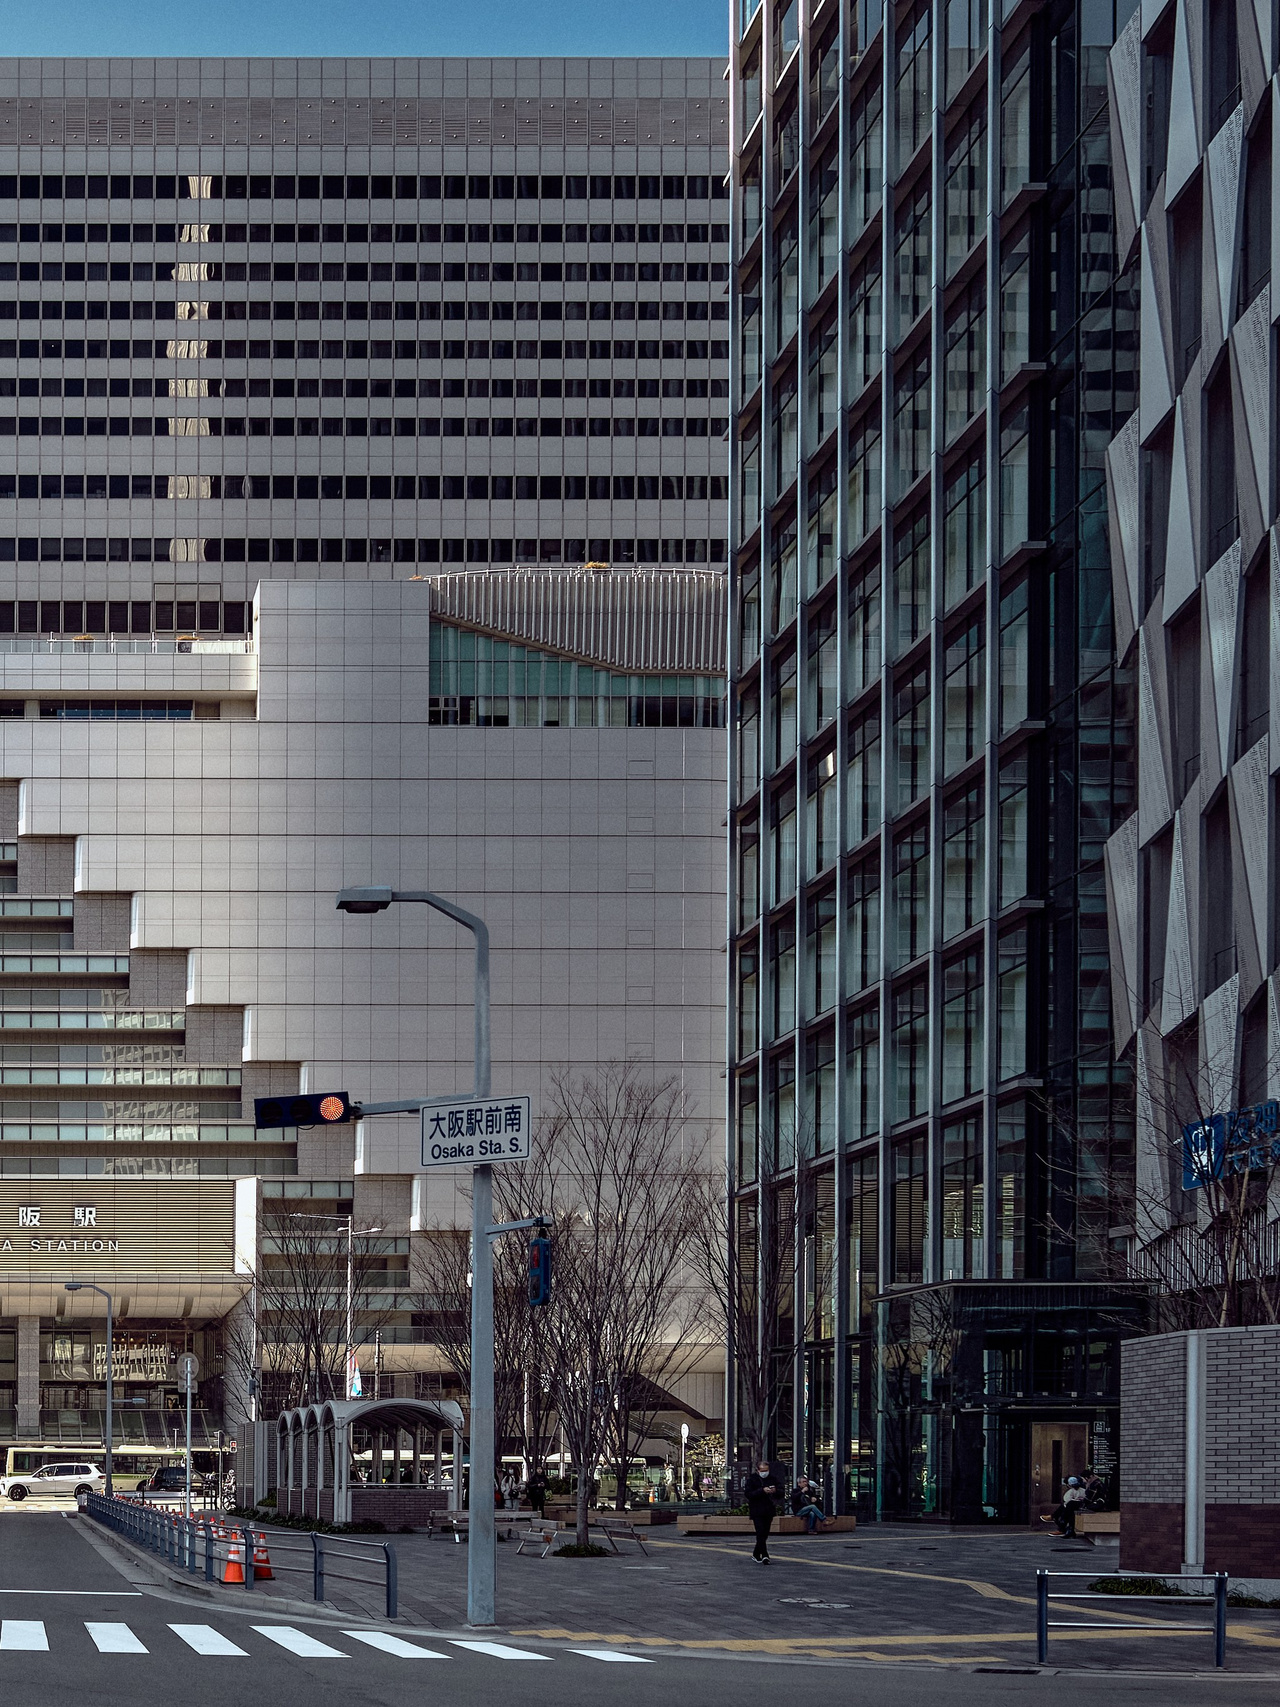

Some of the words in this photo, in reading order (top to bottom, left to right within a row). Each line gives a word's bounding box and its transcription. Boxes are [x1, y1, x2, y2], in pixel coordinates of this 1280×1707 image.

[429, 1104, 522, 1140] 大阪駅前南
[431, 1143, 474, 1159] Osaka
[479, 1139, 505, 1156] Sta.
[509, 1137, 523, 1153] S.
[31, 1239, 119, 1252] STATION
